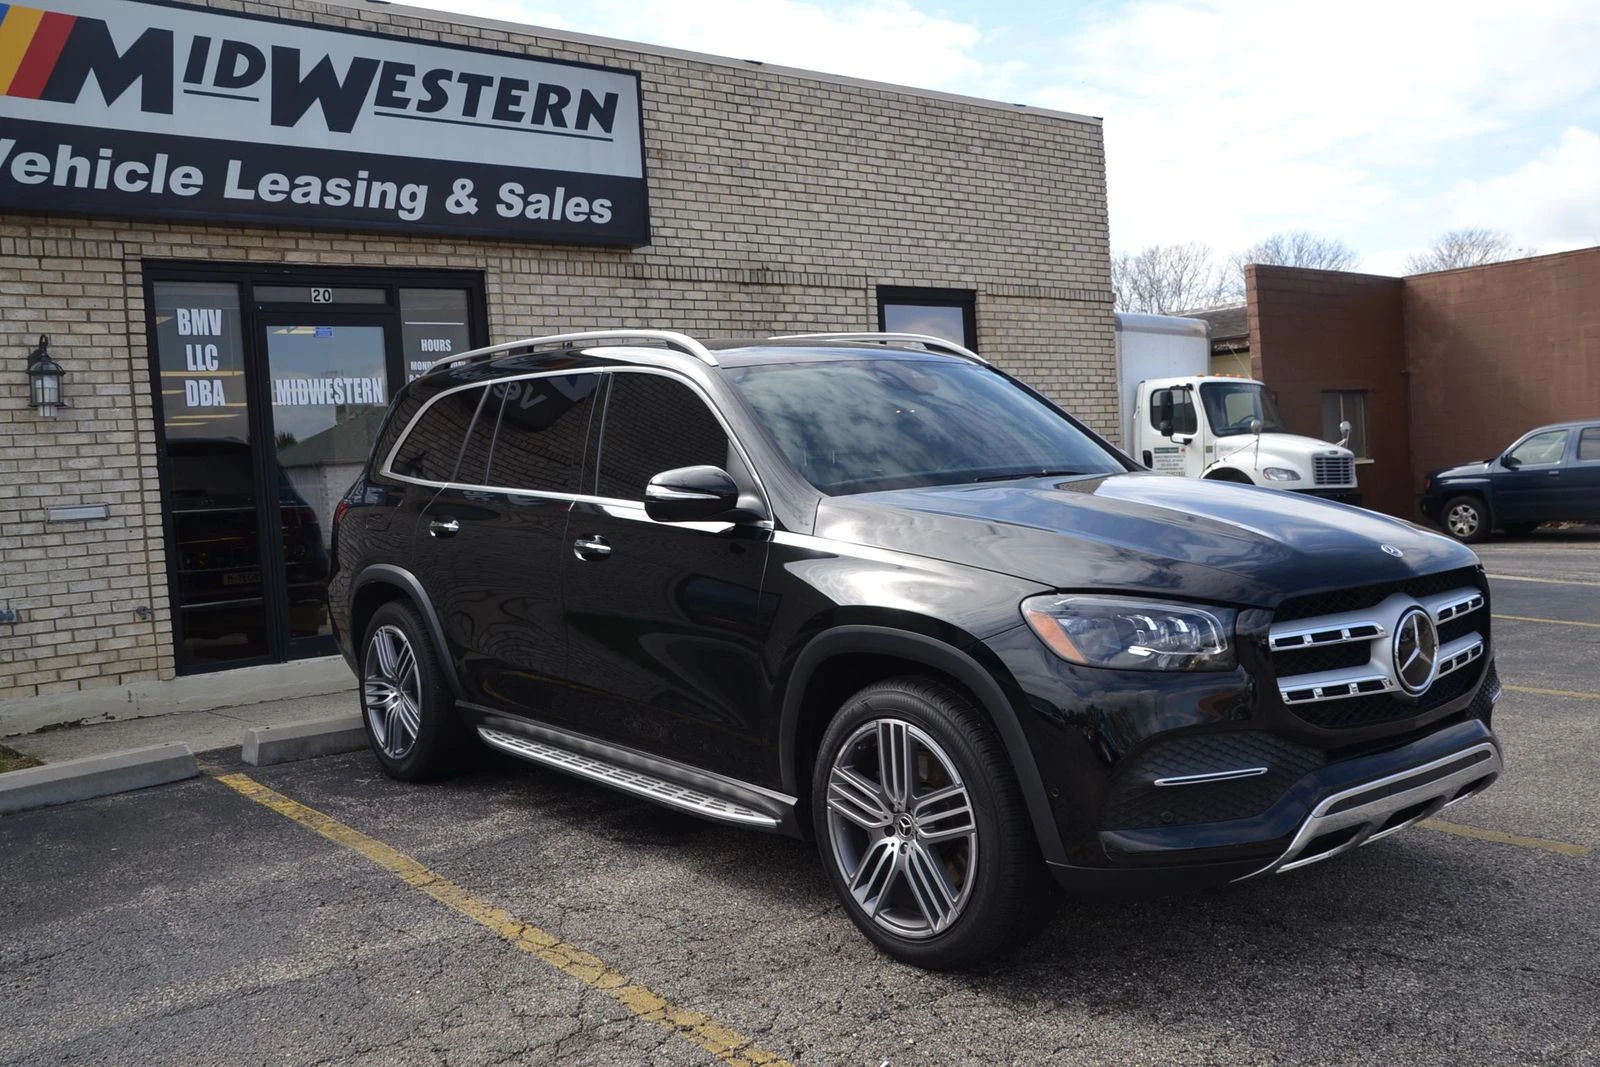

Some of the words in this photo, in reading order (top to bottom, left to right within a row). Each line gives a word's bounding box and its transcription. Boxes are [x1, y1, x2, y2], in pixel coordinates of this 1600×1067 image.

[223, 159, 428, 221] Leasing
[445, 178, 479, 216] &
[496, 182, 613, 224] Sales
[313, 289, 331, 302] 20
[176, 308, 222, 336] BMV
[185, 344, 218, 371] LLC
[421, 339, 452, 352] HOURS
[185, 379, 225, 407] DBA
[275, 377, 383, 406] MIDWESTERN
